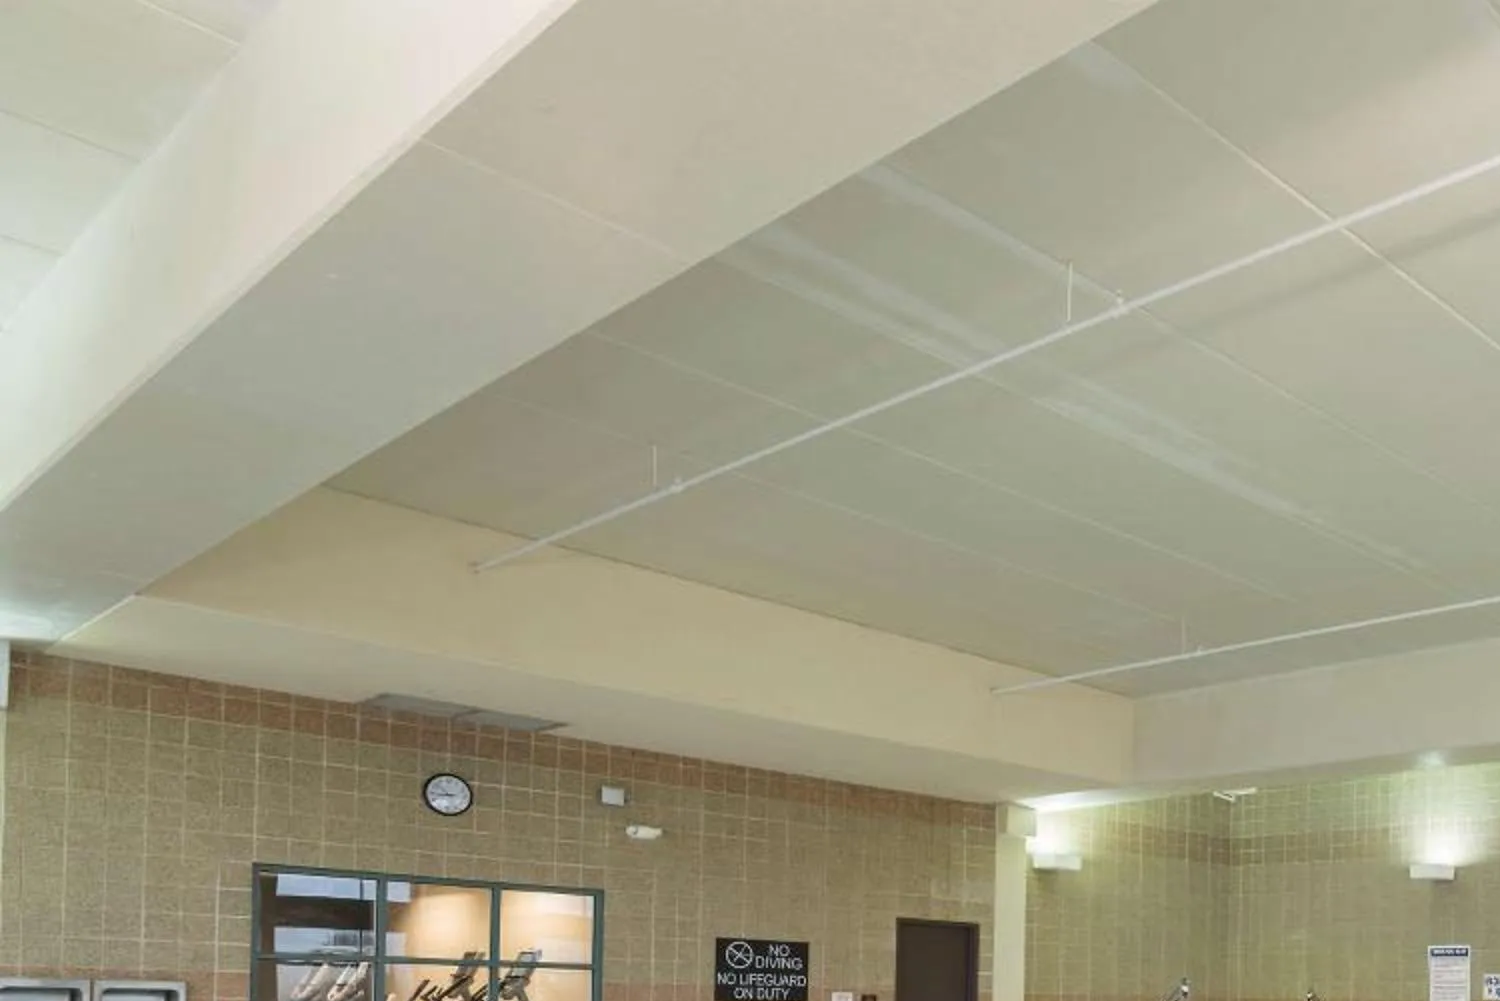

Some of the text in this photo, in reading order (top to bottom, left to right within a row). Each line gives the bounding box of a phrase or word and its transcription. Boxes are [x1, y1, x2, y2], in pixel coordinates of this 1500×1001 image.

[769, 944, 791, 957] NO
[755, 956, 804, 970] DIVING
[717, 972, 807, 987] NO LIFEGUARD
[734, 988, 791, 1000] ON DUTY
